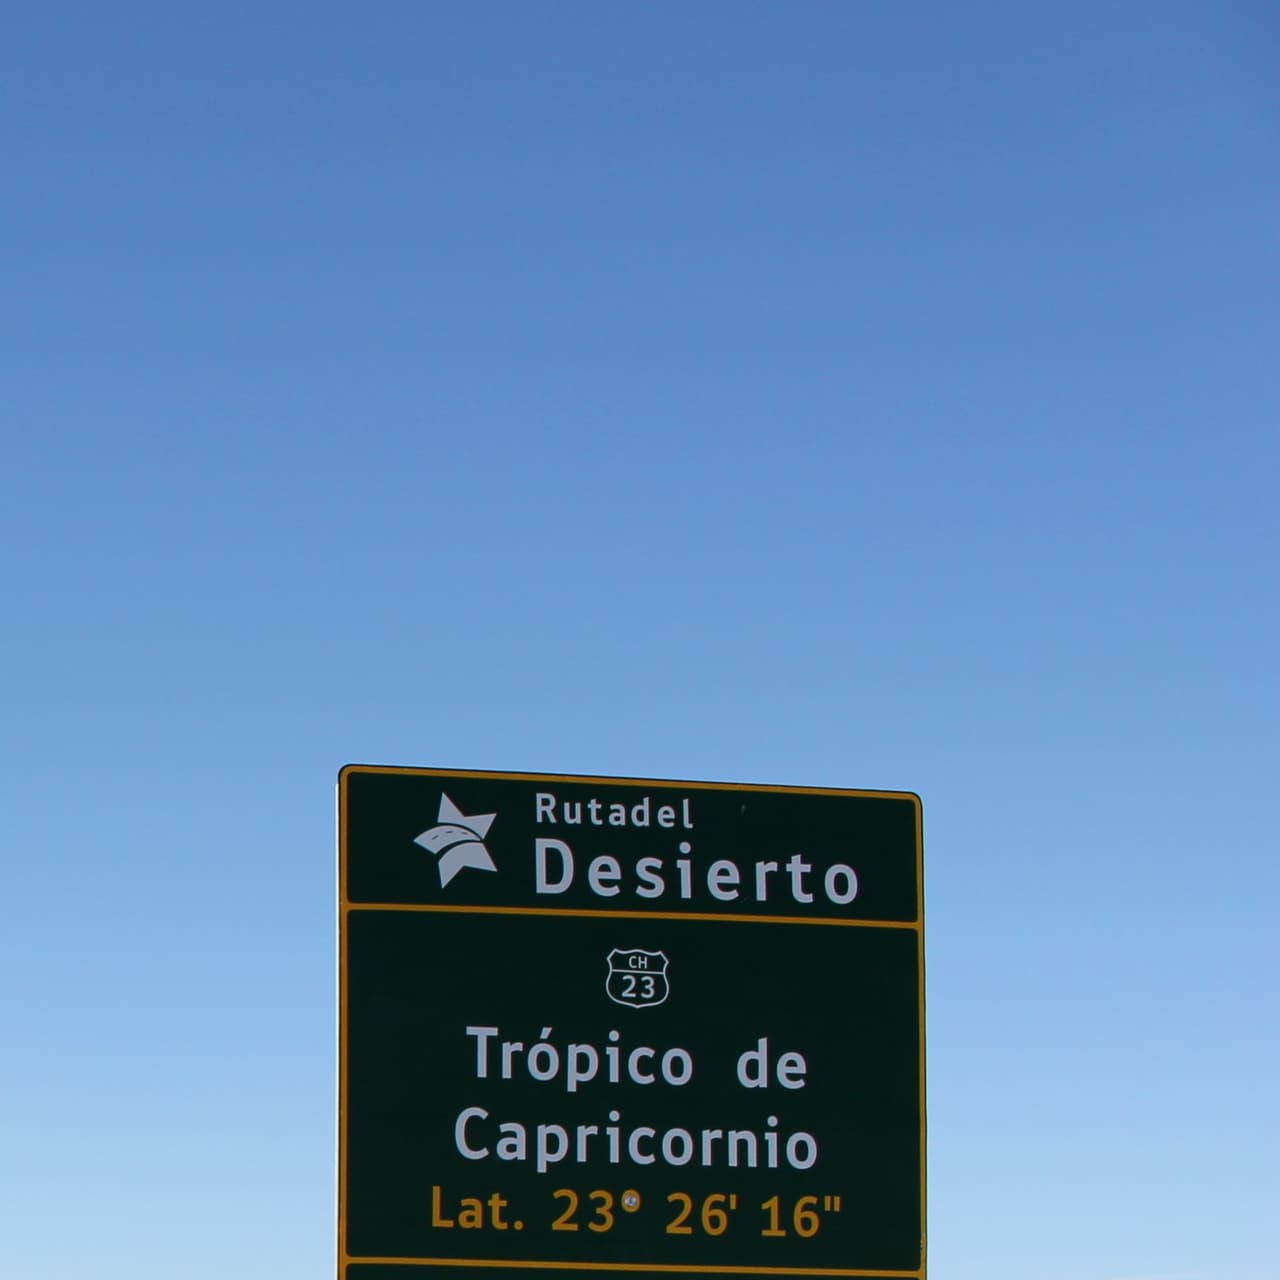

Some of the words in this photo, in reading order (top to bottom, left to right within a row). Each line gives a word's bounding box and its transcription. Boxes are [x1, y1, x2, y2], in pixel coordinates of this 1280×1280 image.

[535, 792, 694, 829] Rutadel
[535, 837, 858, 905] Desierto
[621, 974, 655, 998] 23
[628, 955, 648, 969] CH
[465, 1025, 693, 1093] Trópico
[736, 1037, 807, 1090] de
[454, 1106, 818, 1174] Capricornio
[432, 1185, 524, 1230] Lat.
[666, 1192, 737, 1236] 26'
[761, 1195, 841, 1238] 16"
